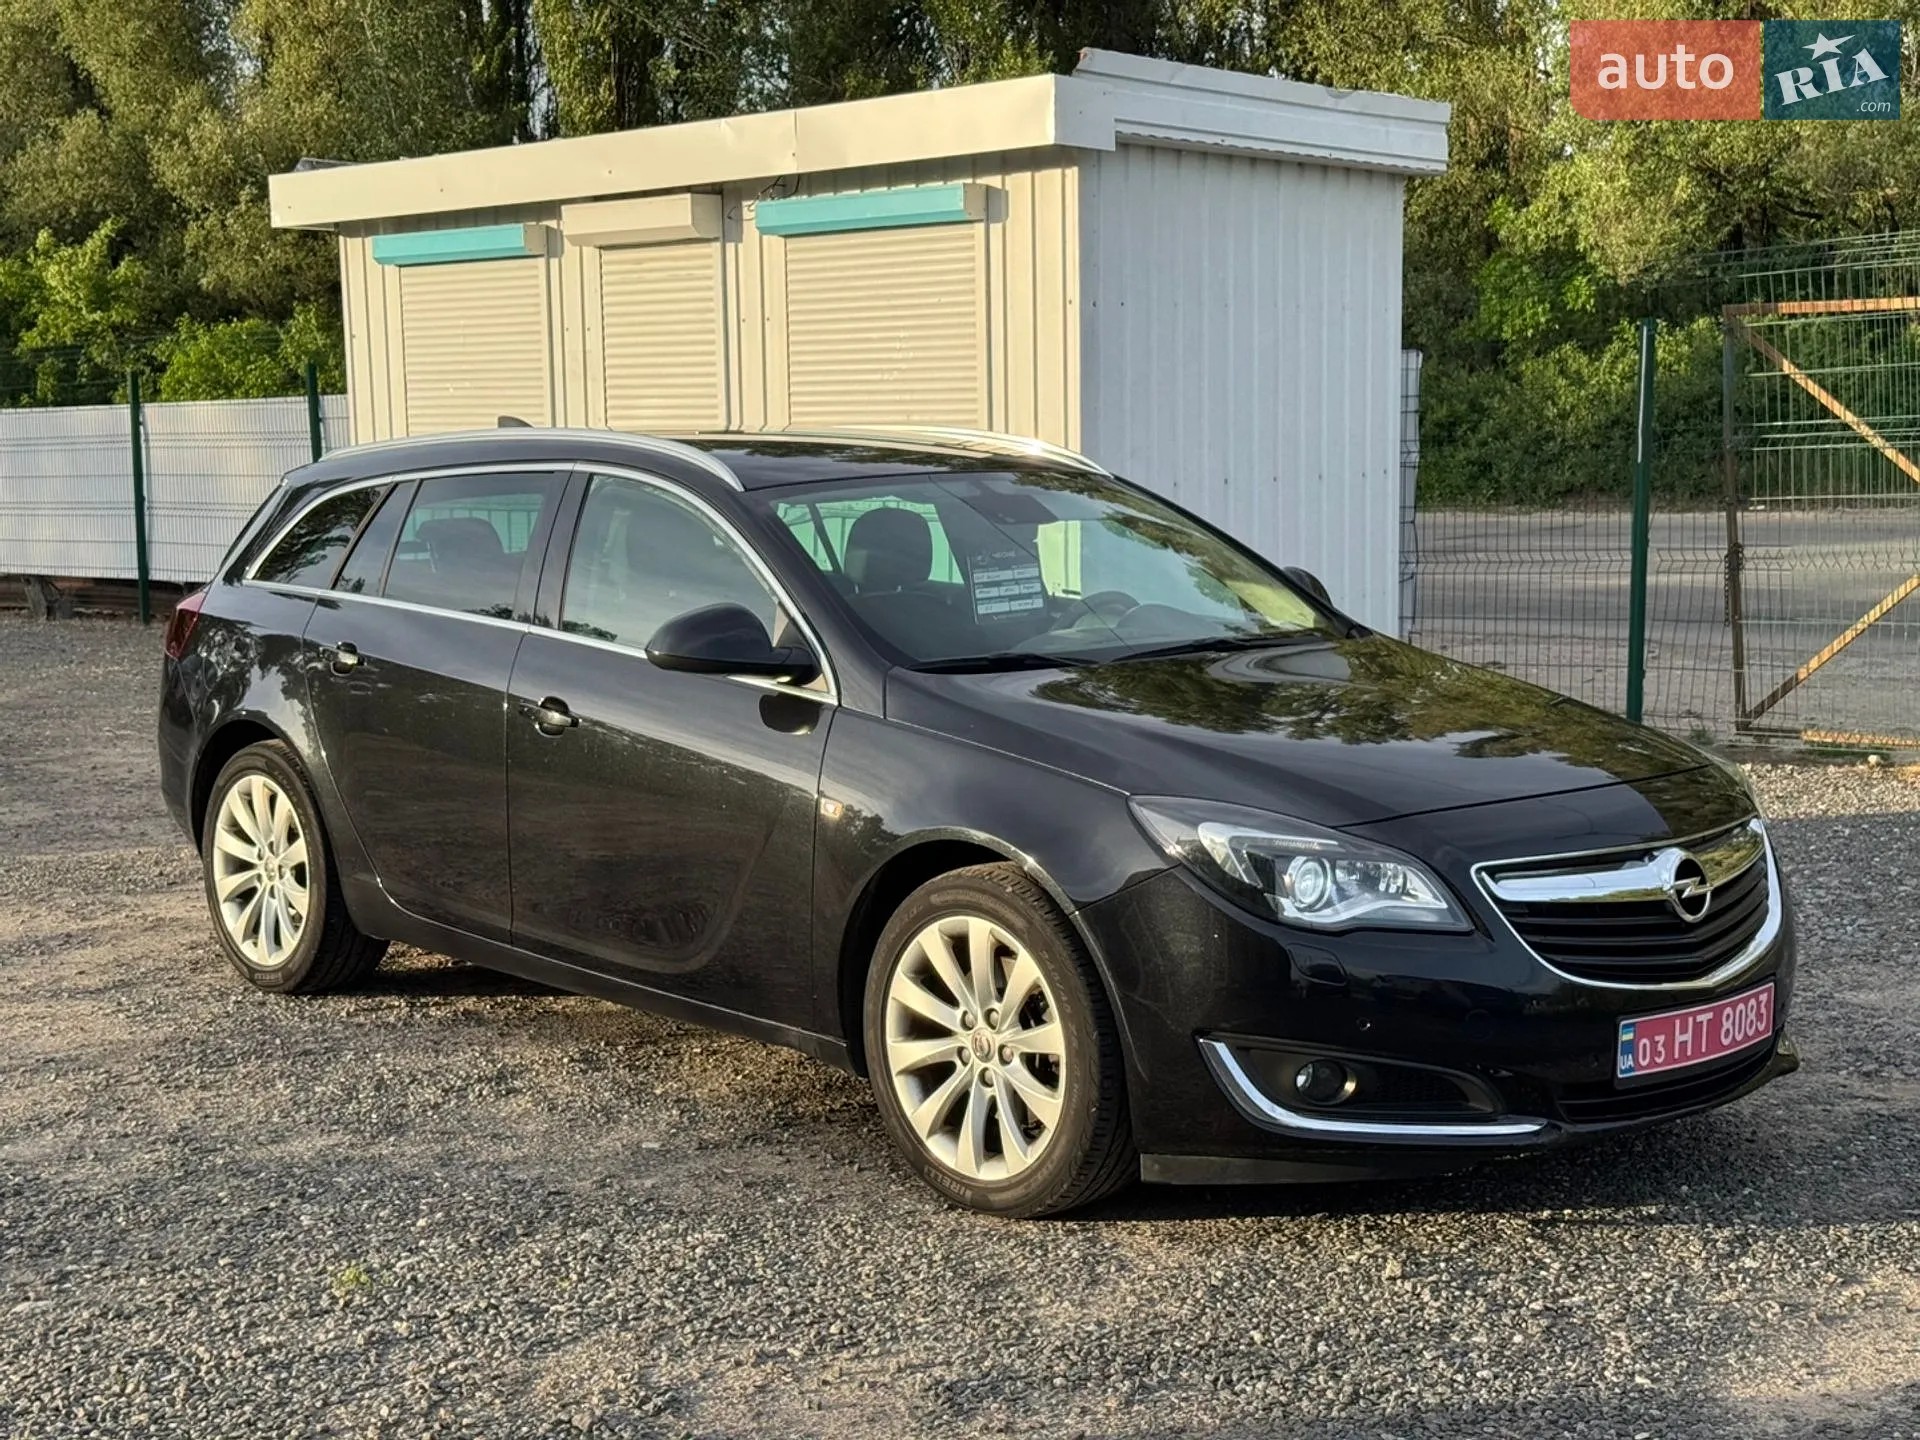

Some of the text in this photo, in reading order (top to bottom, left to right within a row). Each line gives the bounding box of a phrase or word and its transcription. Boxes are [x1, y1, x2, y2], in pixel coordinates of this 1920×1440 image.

[1638, 992, 1768, 1067] 03 HT 8083
[1619, 1055, 1634, 1070] UA
